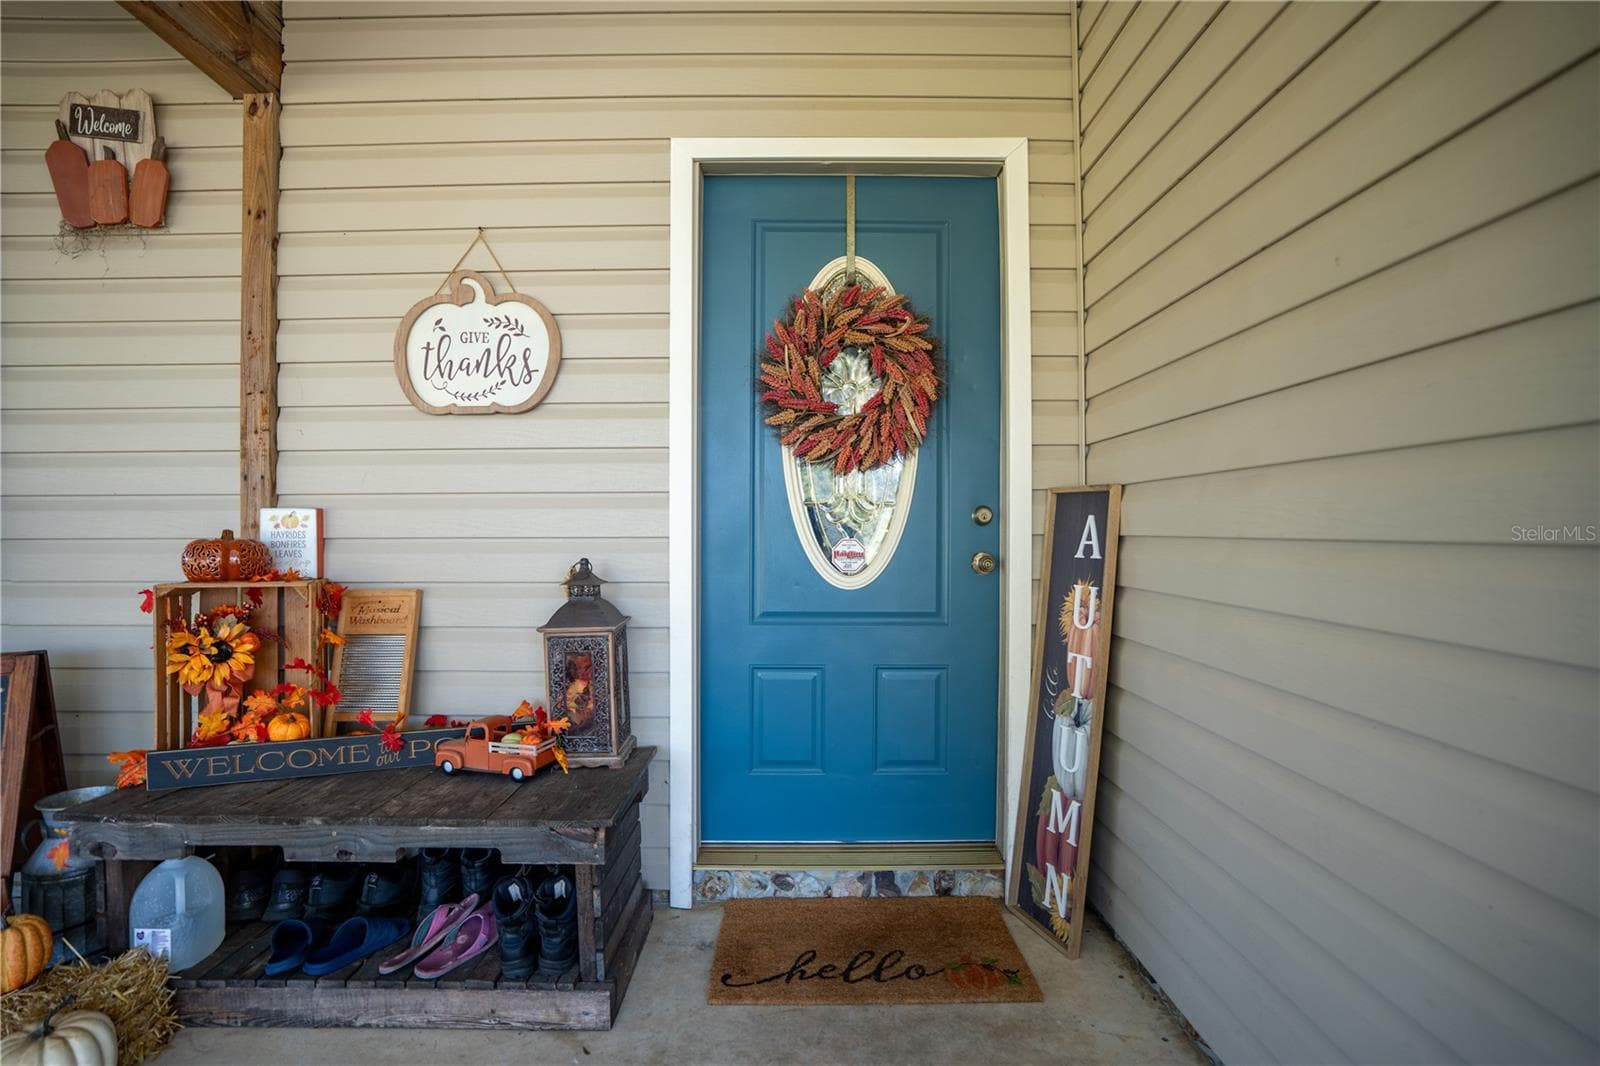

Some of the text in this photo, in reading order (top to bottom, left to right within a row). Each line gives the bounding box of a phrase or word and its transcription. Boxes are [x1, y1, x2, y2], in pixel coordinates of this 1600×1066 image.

[74, 106, 132, 137] Welcome
[459, 331, 490, 344] GIVE
[420, 333, 539, 387] thanks
[270, 530, 306, 539] HAYRIDES
[270, 540, 306, 549] BONFIRES
[274, 549, 303, 558] LEAVES
[356, 603, 402, 616] Musical
[349, 614, 409, 625] Washboard
[1042, 514, 1103, 919] AUTUMN
[161, 743, 371, 780] WELCOME
[376, 751, 401, 767] our
[721, 949, 945, 988] hello
